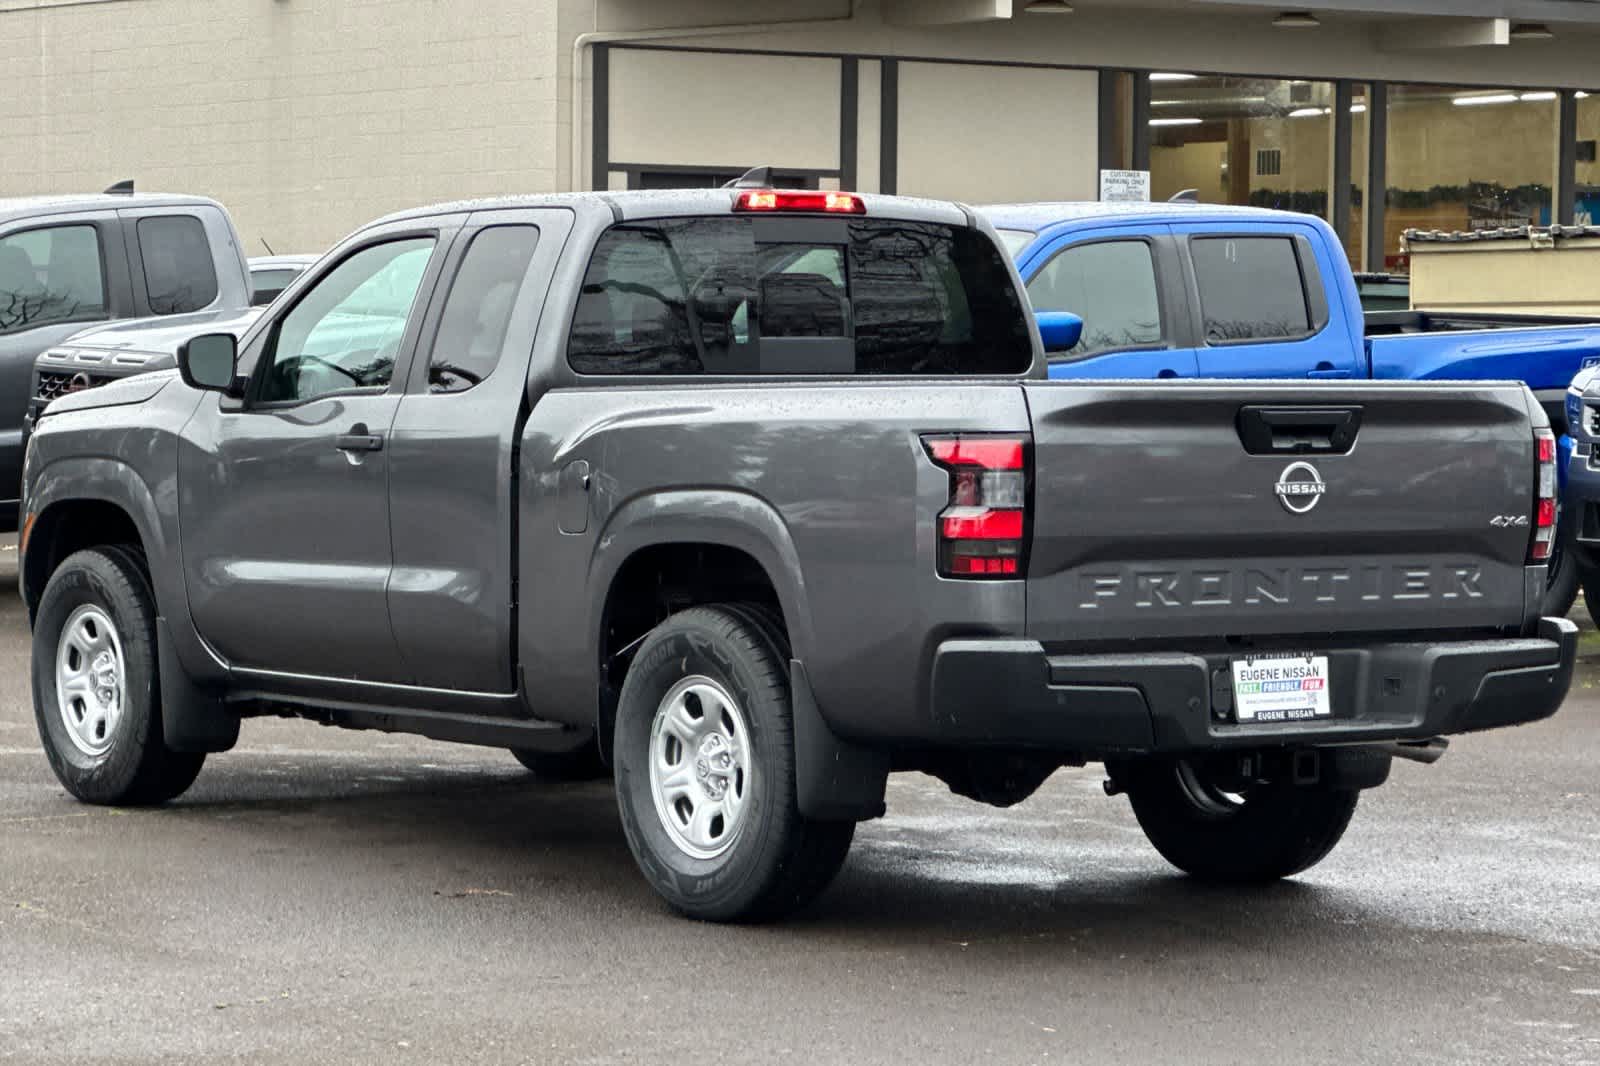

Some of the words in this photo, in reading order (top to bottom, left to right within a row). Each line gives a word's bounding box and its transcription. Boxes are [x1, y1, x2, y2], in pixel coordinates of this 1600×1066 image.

[1275, 484, 1326, 494] NISSAN
[1079, 565, 1483, 608] FRONTIER
[1240, 670, 1280, 681] EUGENE
[1282, 666, 1319, 679] NISSAN
[1257, 711, 1286, 720] EUGENE
[1287, 709, 1314, 719] NISSAN
